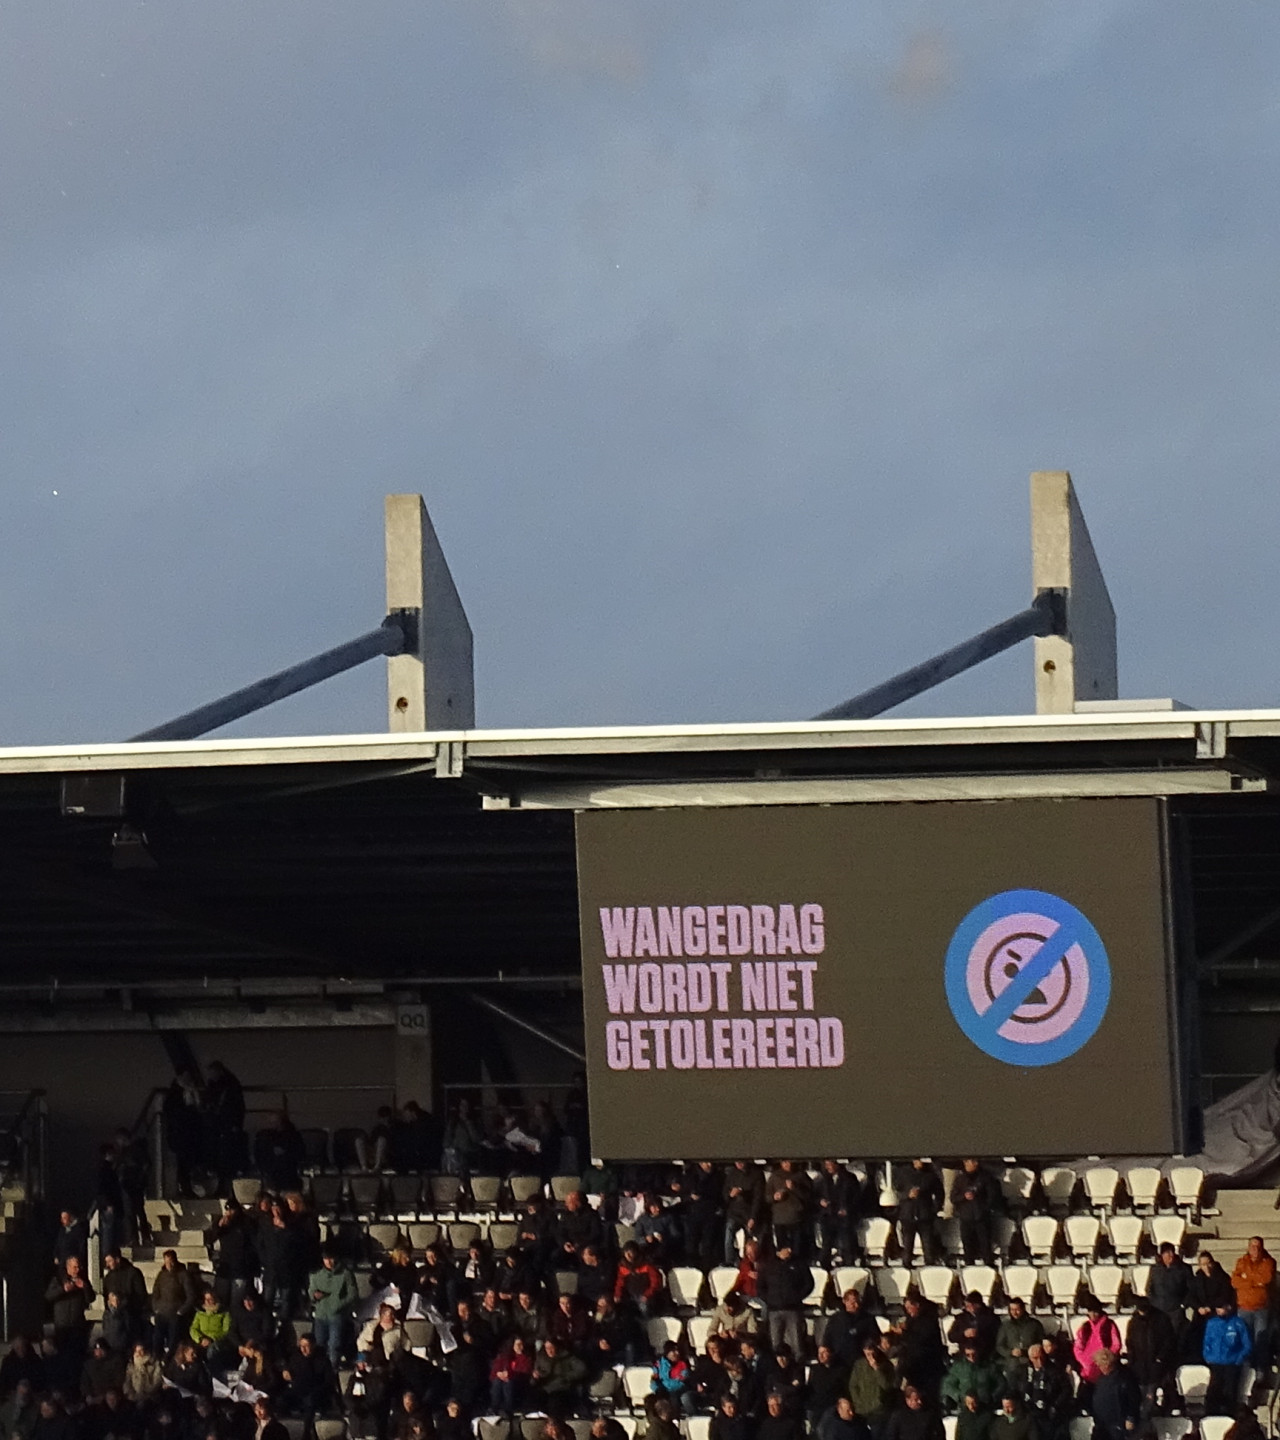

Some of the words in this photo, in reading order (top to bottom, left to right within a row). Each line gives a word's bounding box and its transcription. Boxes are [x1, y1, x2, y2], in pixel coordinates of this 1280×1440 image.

[599, 903, 825, 958] WANGEDRAG
[602, 962, 732, 1014] WORDT
[741, 961, 818, 1011] NIET
[605, 1017, 845, 1070] GETOLEREERD
